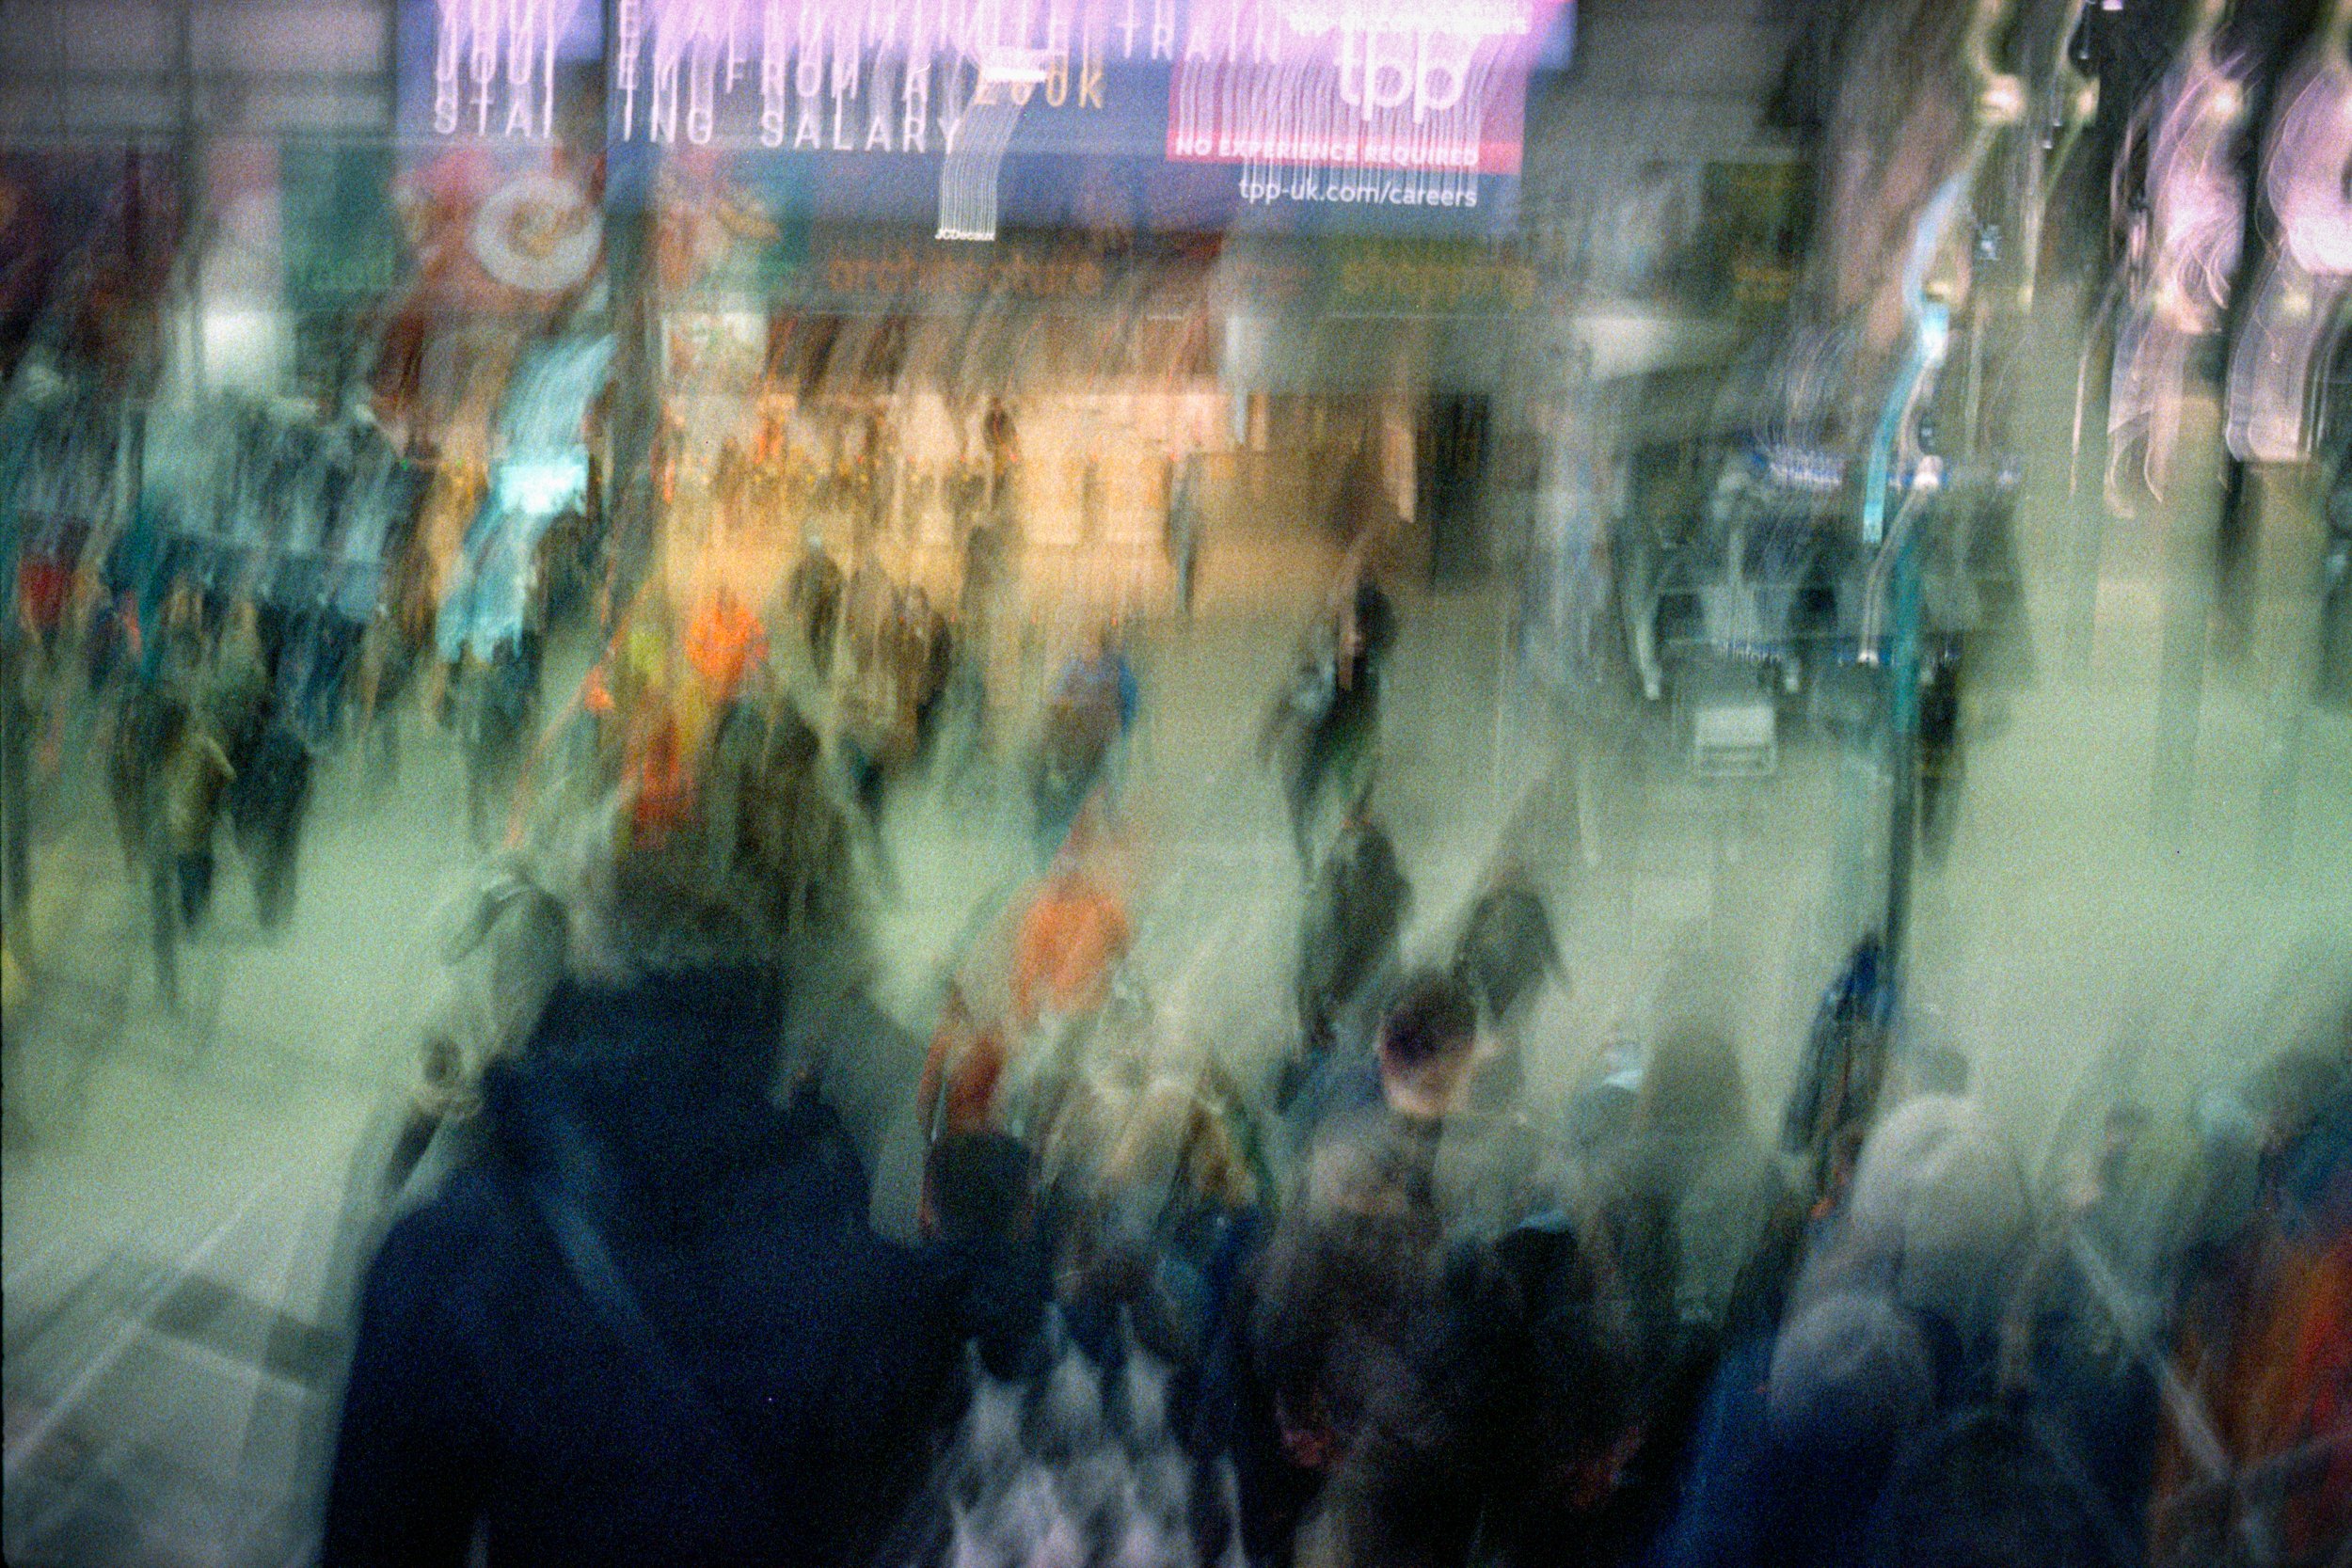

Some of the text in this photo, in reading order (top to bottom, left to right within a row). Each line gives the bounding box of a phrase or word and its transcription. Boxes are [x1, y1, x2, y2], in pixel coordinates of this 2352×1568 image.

[1333, 43, 1466, 123] tpp
[760, 109, 961, 156] SALARY
[1176, 138, 1479, 166] NO EXPERIENCE REQUIRED
[1239, 178, 1478, 208] tpp-uk.com/careers
